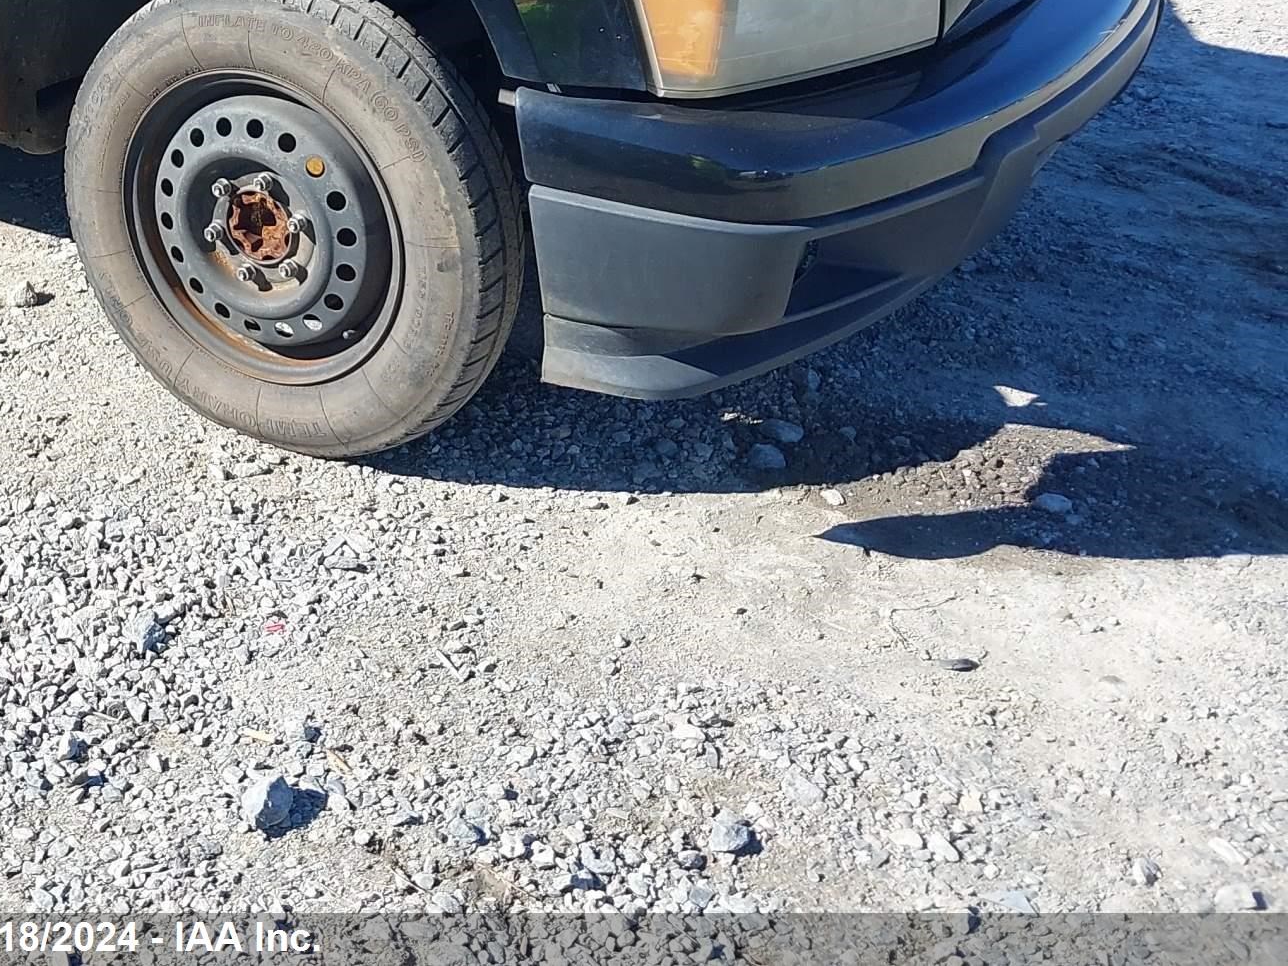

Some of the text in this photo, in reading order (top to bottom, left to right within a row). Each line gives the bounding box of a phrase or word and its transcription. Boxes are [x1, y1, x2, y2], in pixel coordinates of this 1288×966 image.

[198, 13, 265, 33] INFLATE
[272, 25, 295, 41] TO
[297, 35, 334, 62] 420
[335, 58, 372, 92] KPA
